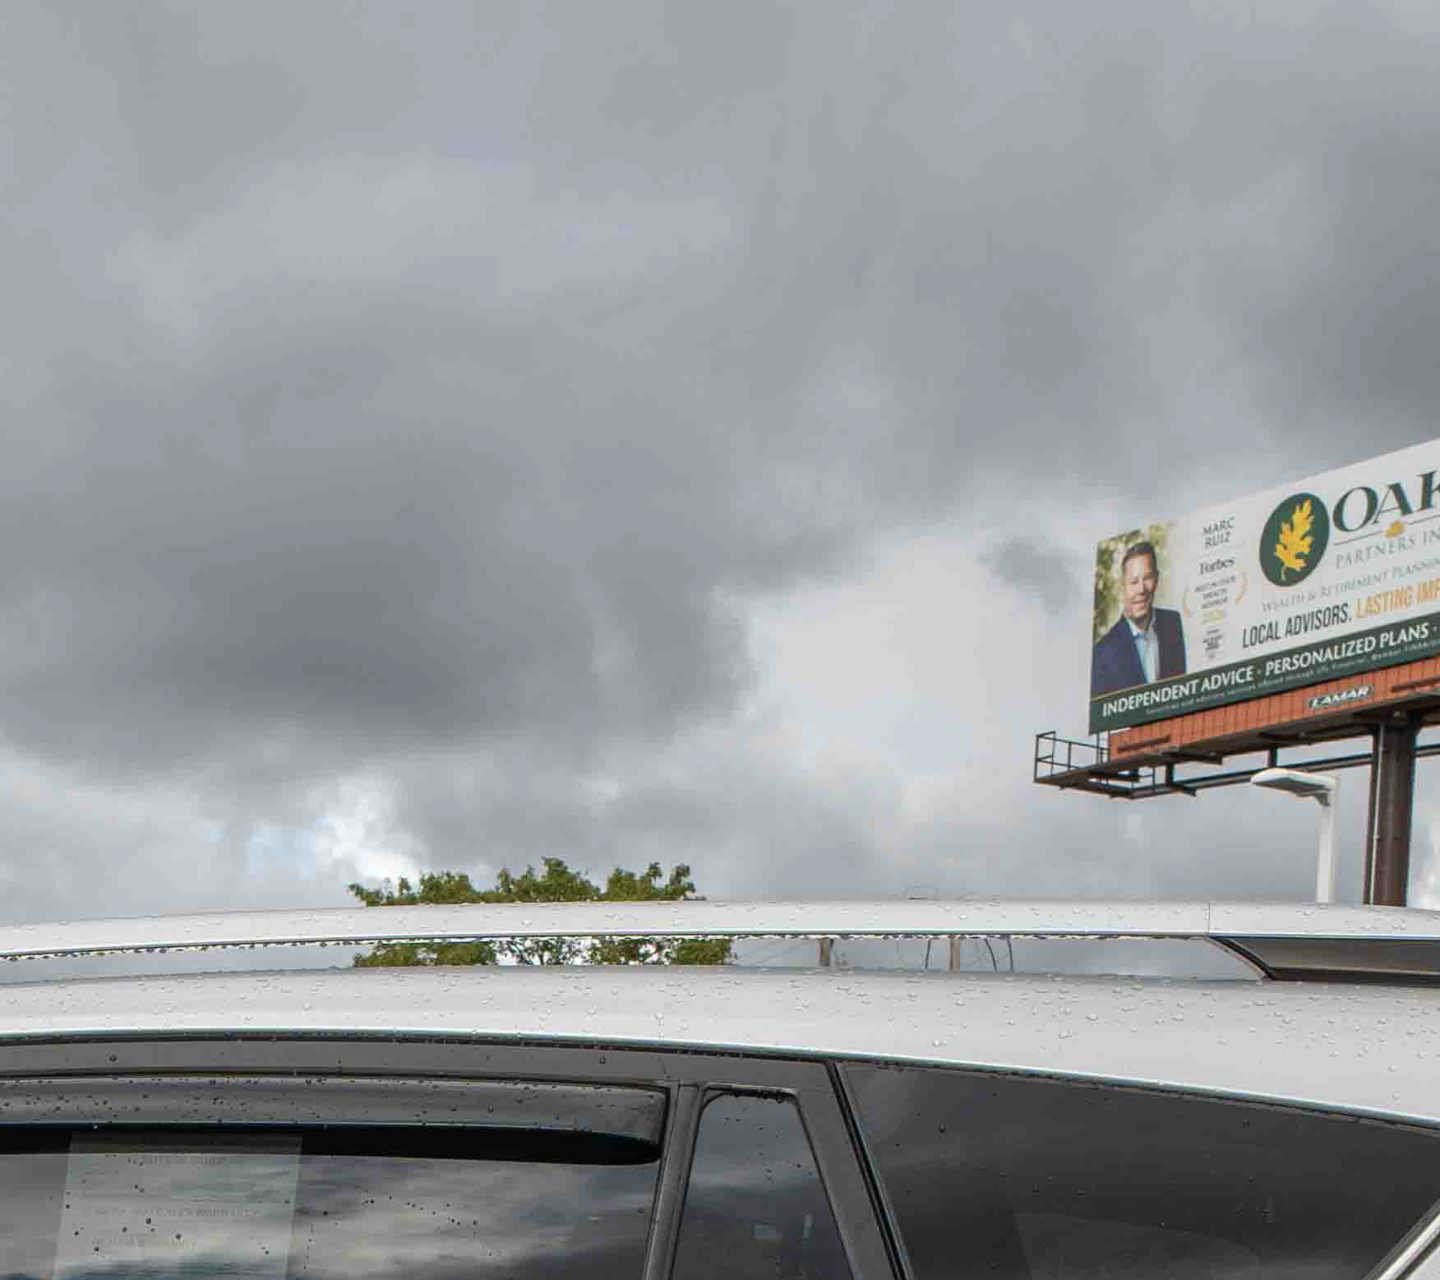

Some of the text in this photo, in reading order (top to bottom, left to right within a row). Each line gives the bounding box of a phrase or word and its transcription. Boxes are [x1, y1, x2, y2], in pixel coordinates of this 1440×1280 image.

[1203, 517, 1235, 536] MARC
[1205, 532, 1231, 549] RUIZ
[1335, 535, 1416, 568] PARTNERS
[1199, 558, 1235, 576] Forbes
[1242, 623, 1281, 649] LOCAL
[1285, 603, 1352, 638] ADVISORS.
[1355, 584, 1415, 618] LASTING
[1102, 680, 1199, 717] INDEPENDENT
[1201, 665, 1254, 692] ADVICE
[1265, 637, 1376, 676] PERSONALIZED
[1379, 622, 1429, 649] PLANS
[1311, 686, 1370, 708] LAMAR
